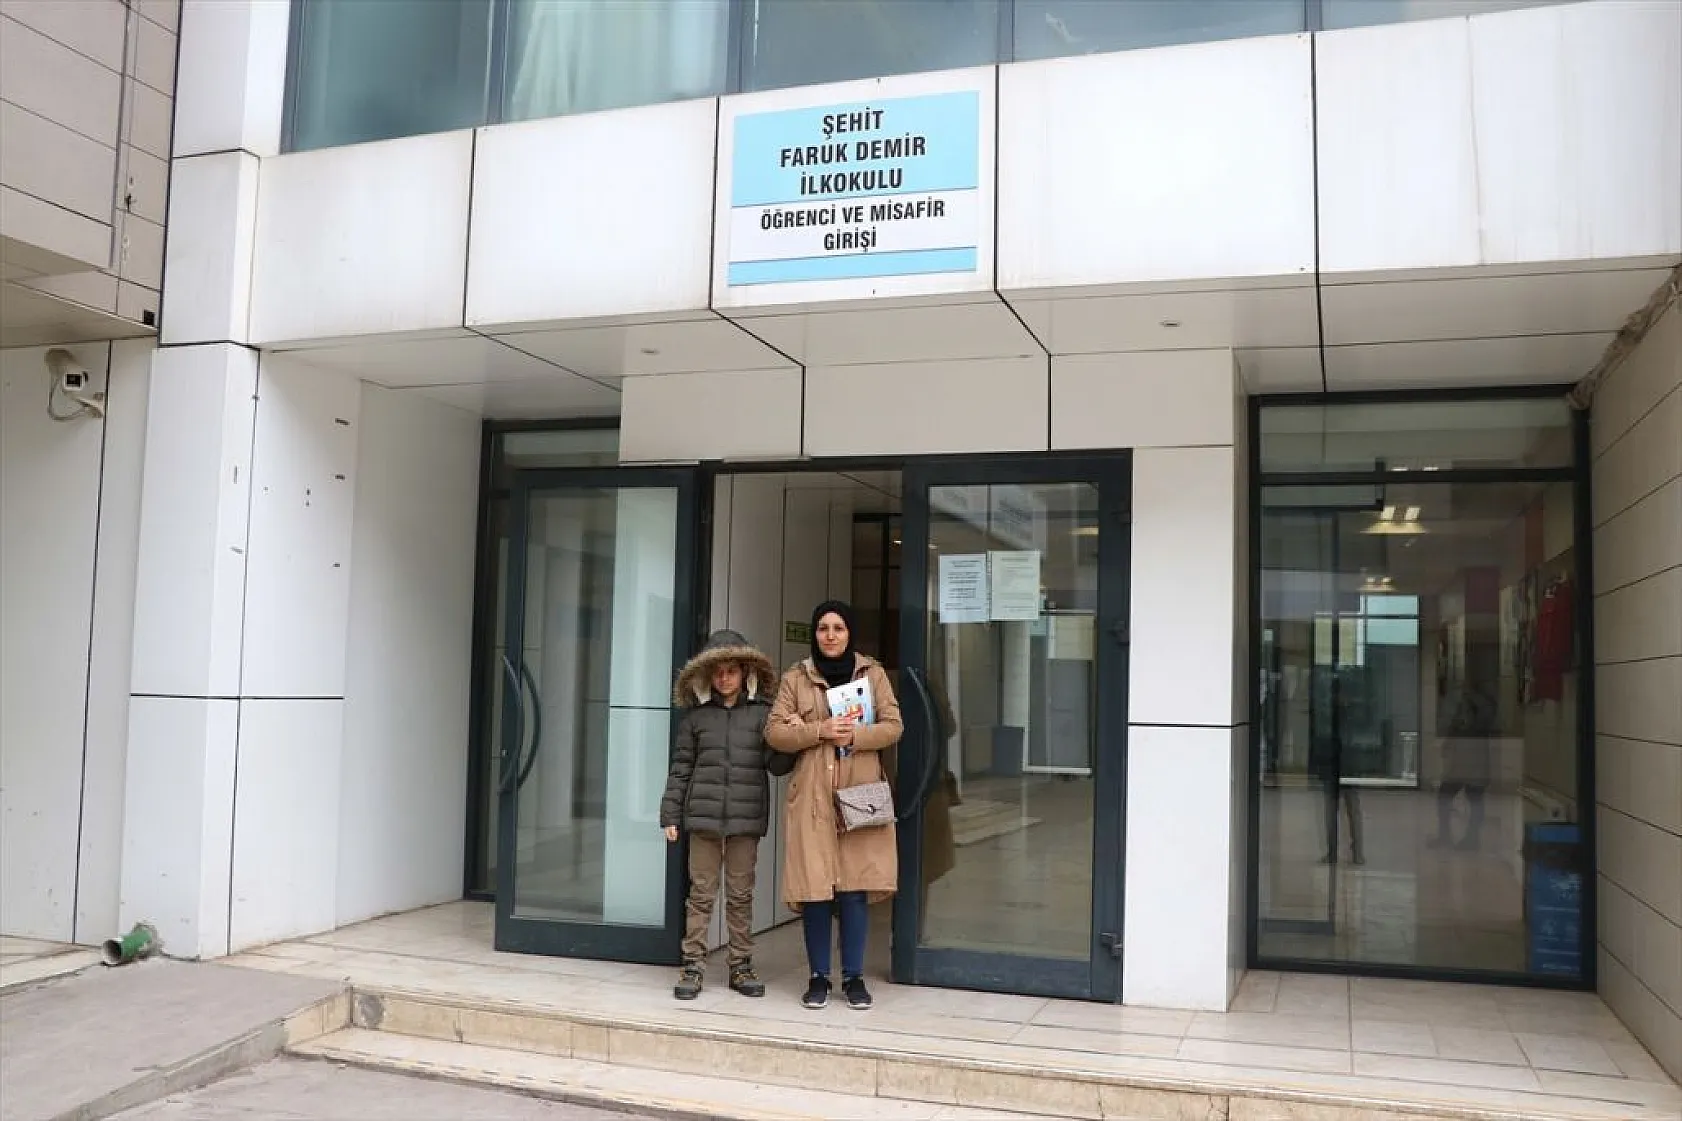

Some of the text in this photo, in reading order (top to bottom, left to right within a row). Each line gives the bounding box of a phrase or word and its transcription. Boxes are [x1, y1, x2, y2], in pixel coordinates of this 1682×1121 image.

[823, 106, 884, 140] ŞEHİT
[780, 132, 926, 167] FARUK DEMİR
[800, 168, 903, 195] İLKOKULU
[761, 196, 945, 230] ÖĞRENCİ VE MİSAFİR
[824, 226, 877, 253] GİRİŞİ
